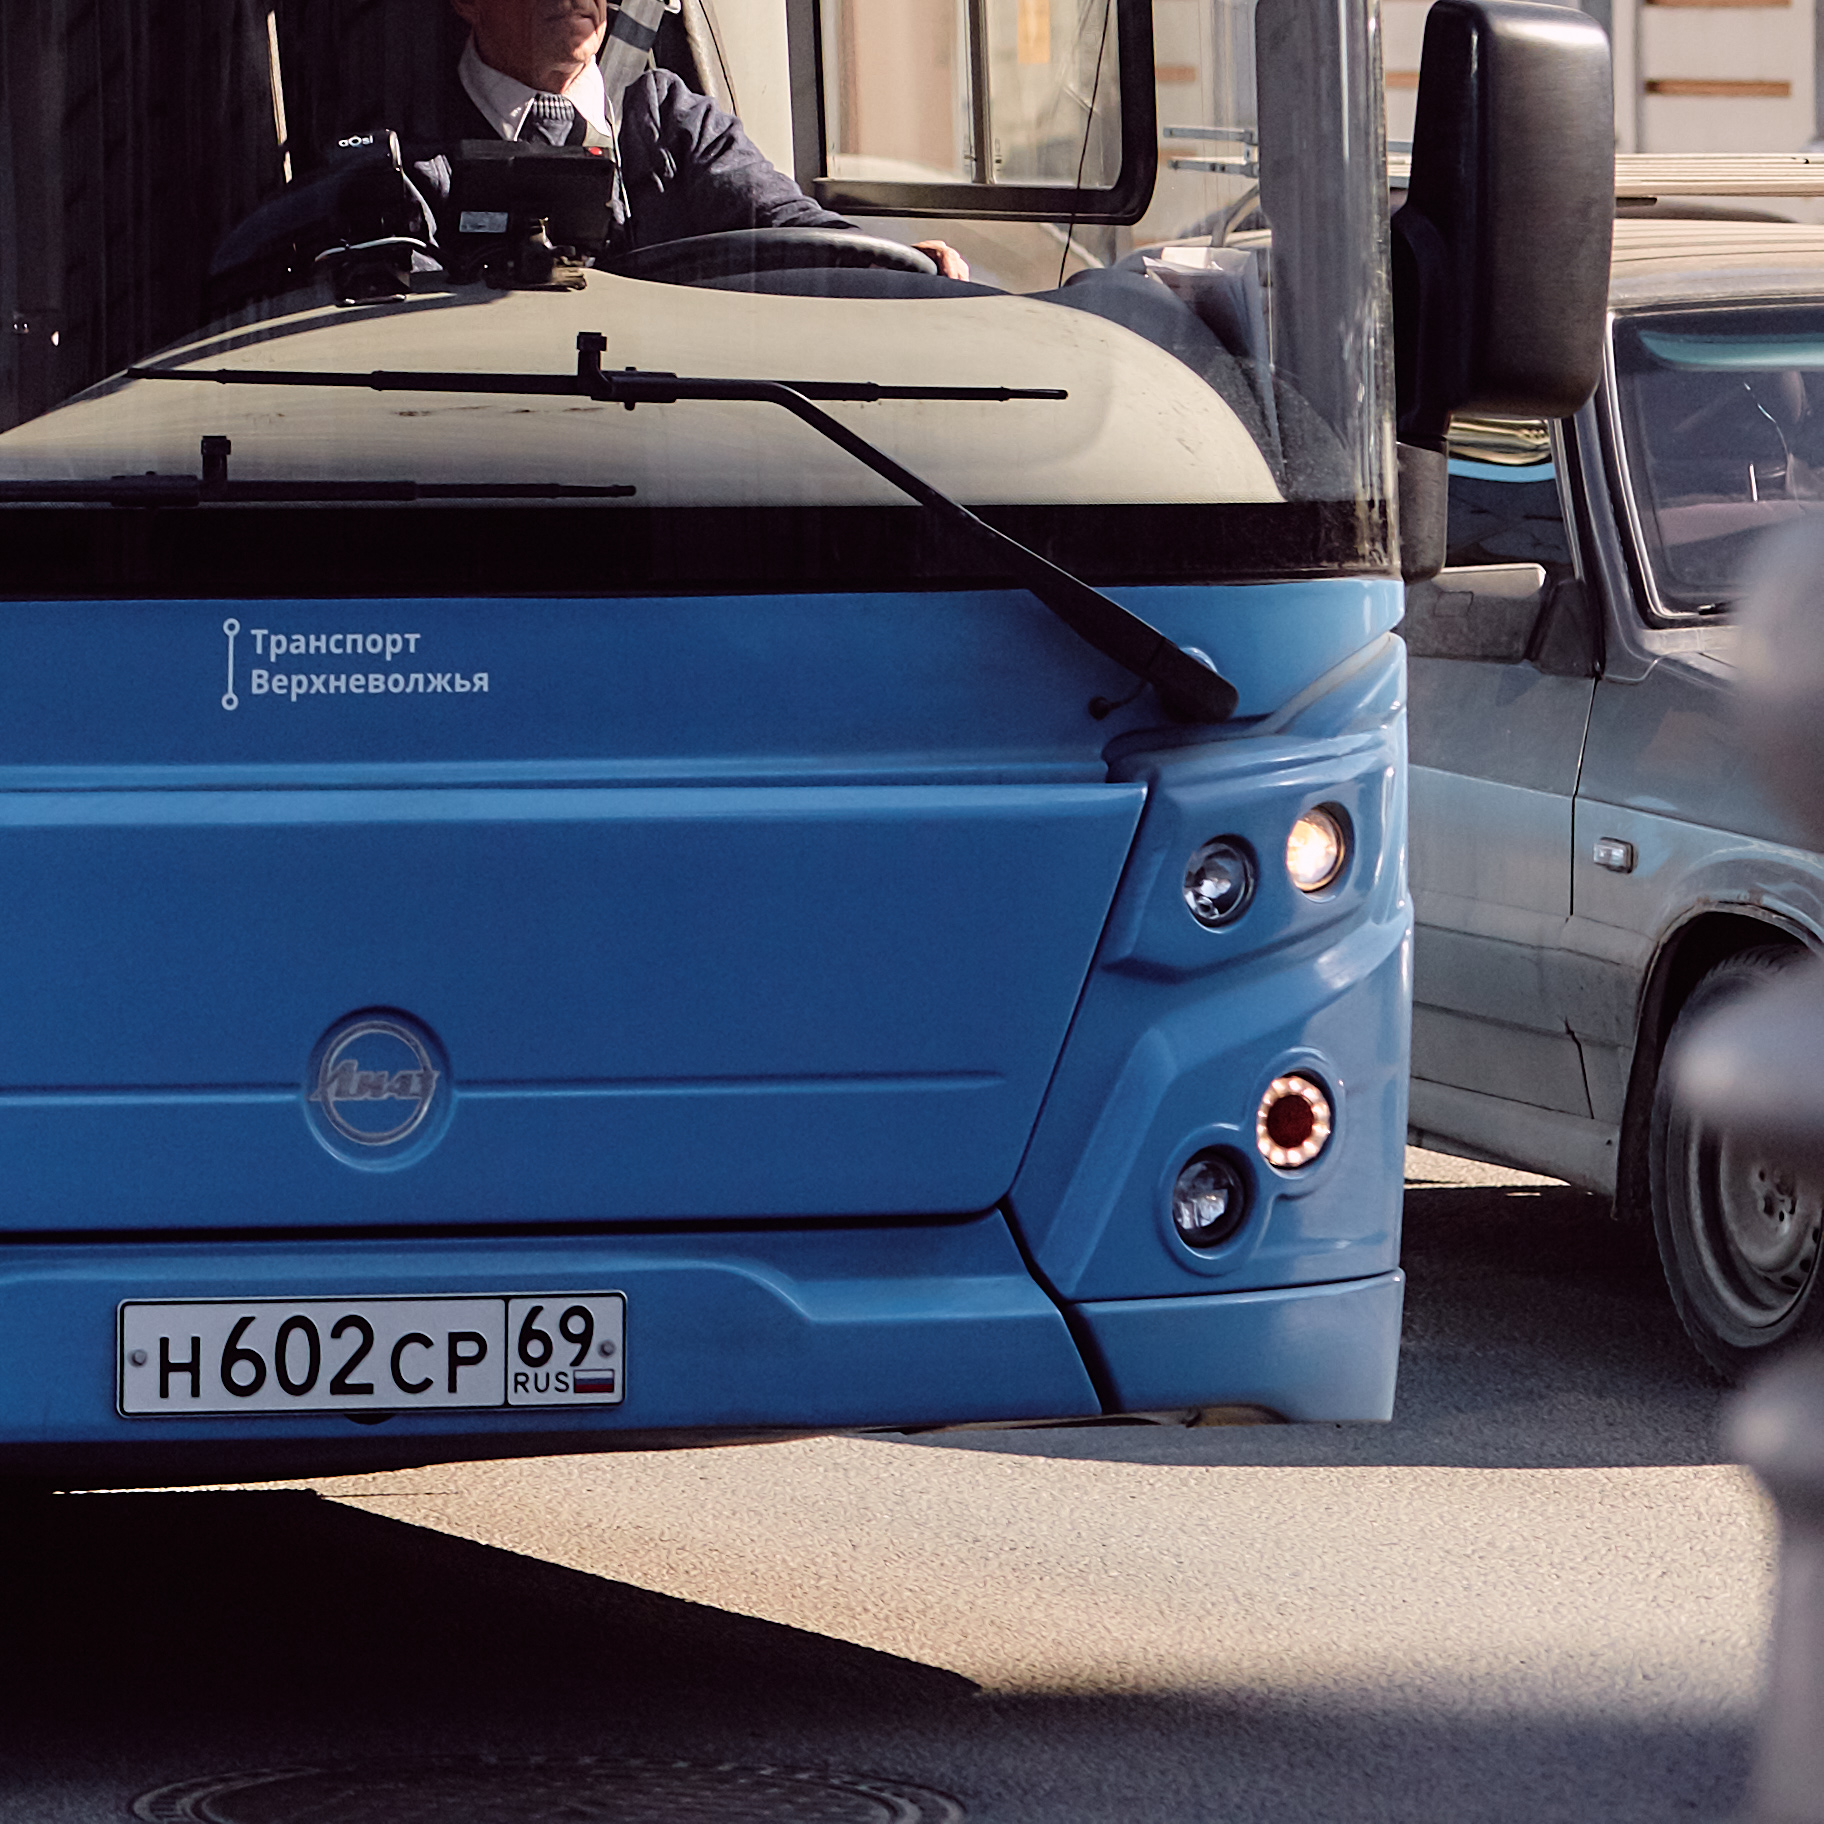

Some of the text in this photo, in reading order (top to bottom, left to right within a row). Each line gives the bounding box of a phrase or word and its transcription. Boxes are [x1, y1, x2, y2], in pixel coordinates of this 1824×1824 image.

[250, 628, 421, 662] Транспорт
[250, 668, 490, 702] Верхневолжья
[517, 1304, 595, 1368] 69
[513, 1370, 571, 1394] RUS
